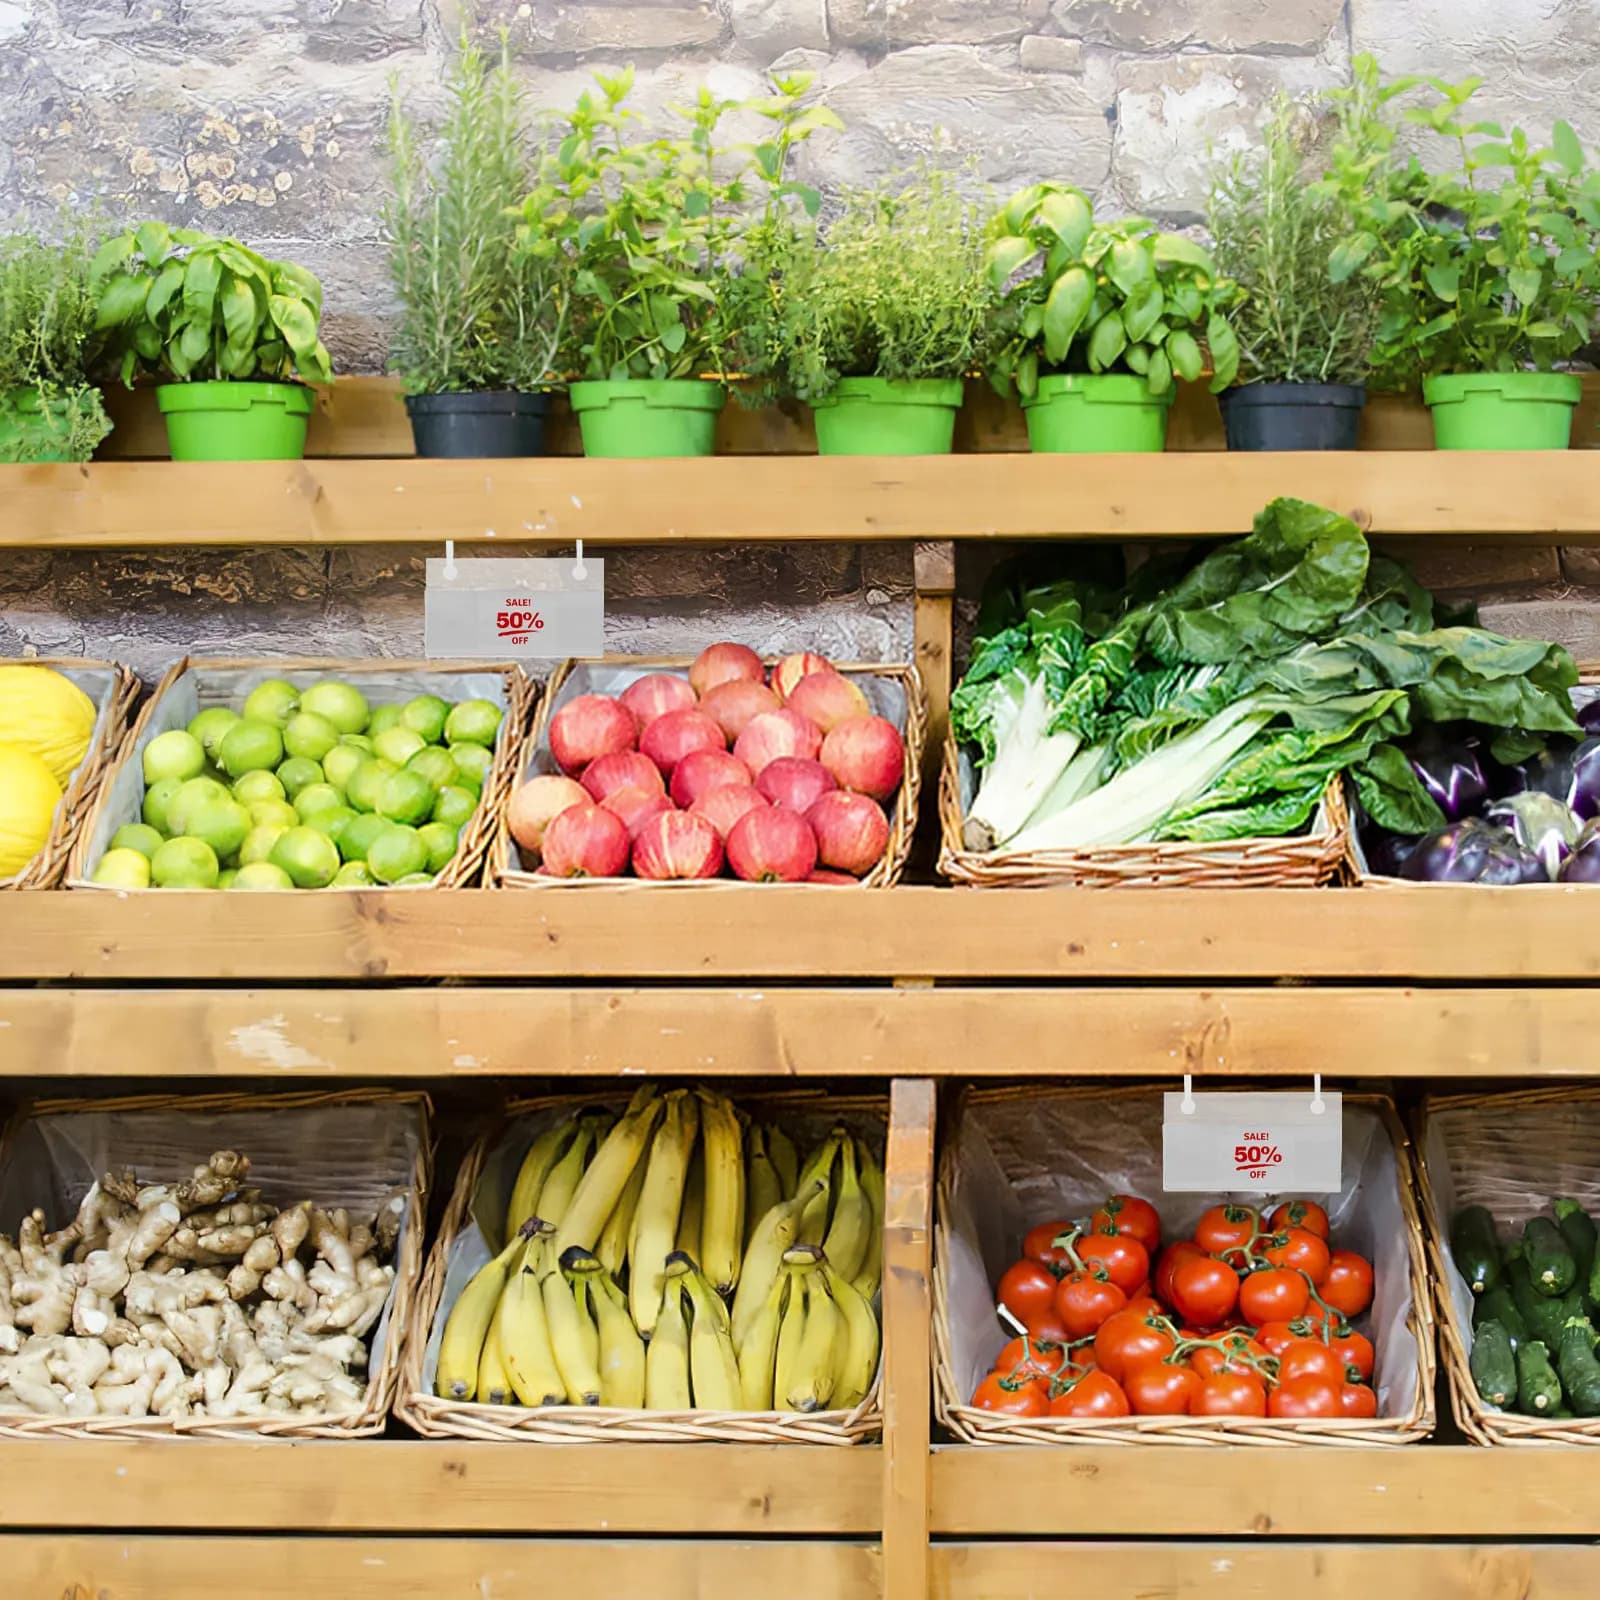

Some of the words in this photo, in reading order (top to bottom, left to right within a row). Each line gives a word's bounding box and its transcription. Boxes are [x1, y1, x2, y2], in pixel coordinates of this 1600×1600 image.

[505, 598, 531, 607] SALE!
[496, 611, 544, 629] 50%
[511, 636, 529, 645] OFF
[1243, 1132, 1269, 1141] SALE!
[1234, 1145, 1282, 1163] 50%
[1249, 1170, 1267, 1179] OFF
